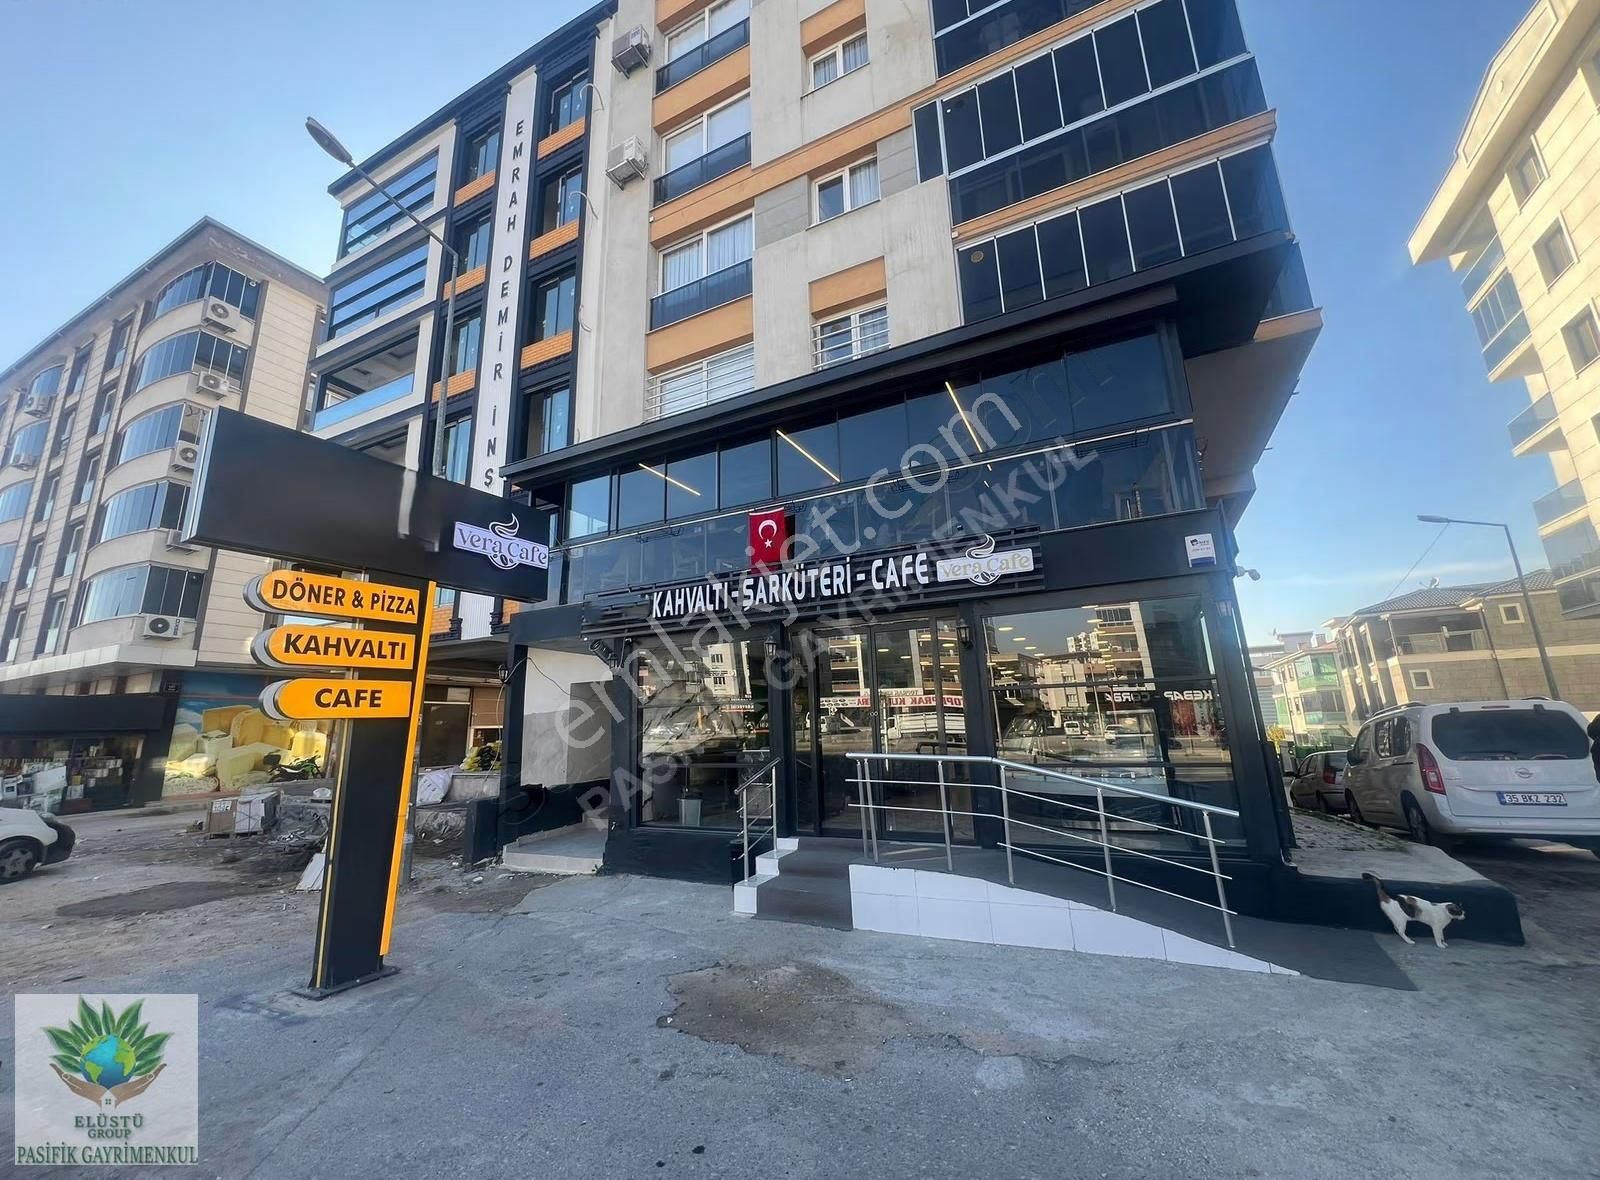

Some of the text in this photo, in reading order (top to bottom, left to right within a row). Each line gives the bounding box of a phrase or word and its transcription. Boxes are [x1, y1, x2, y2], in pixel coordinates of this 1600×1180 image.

[506, 119, 524, 232] EMRAH
[493, 255, 513, 382] DEMİR
[458, 528, 548, 565] Vera Cafe
[940, 552, 1030, 578] Vera Cafe
[871, 552, 929, 590] CAFE
[272, 577, 416, 616] DÖNER & PİZZA
[283, 633, 407, 661] KAHVALTI
[314, 688, 383, 709] CAFE
[1505, 794, 1519, 803] 35
